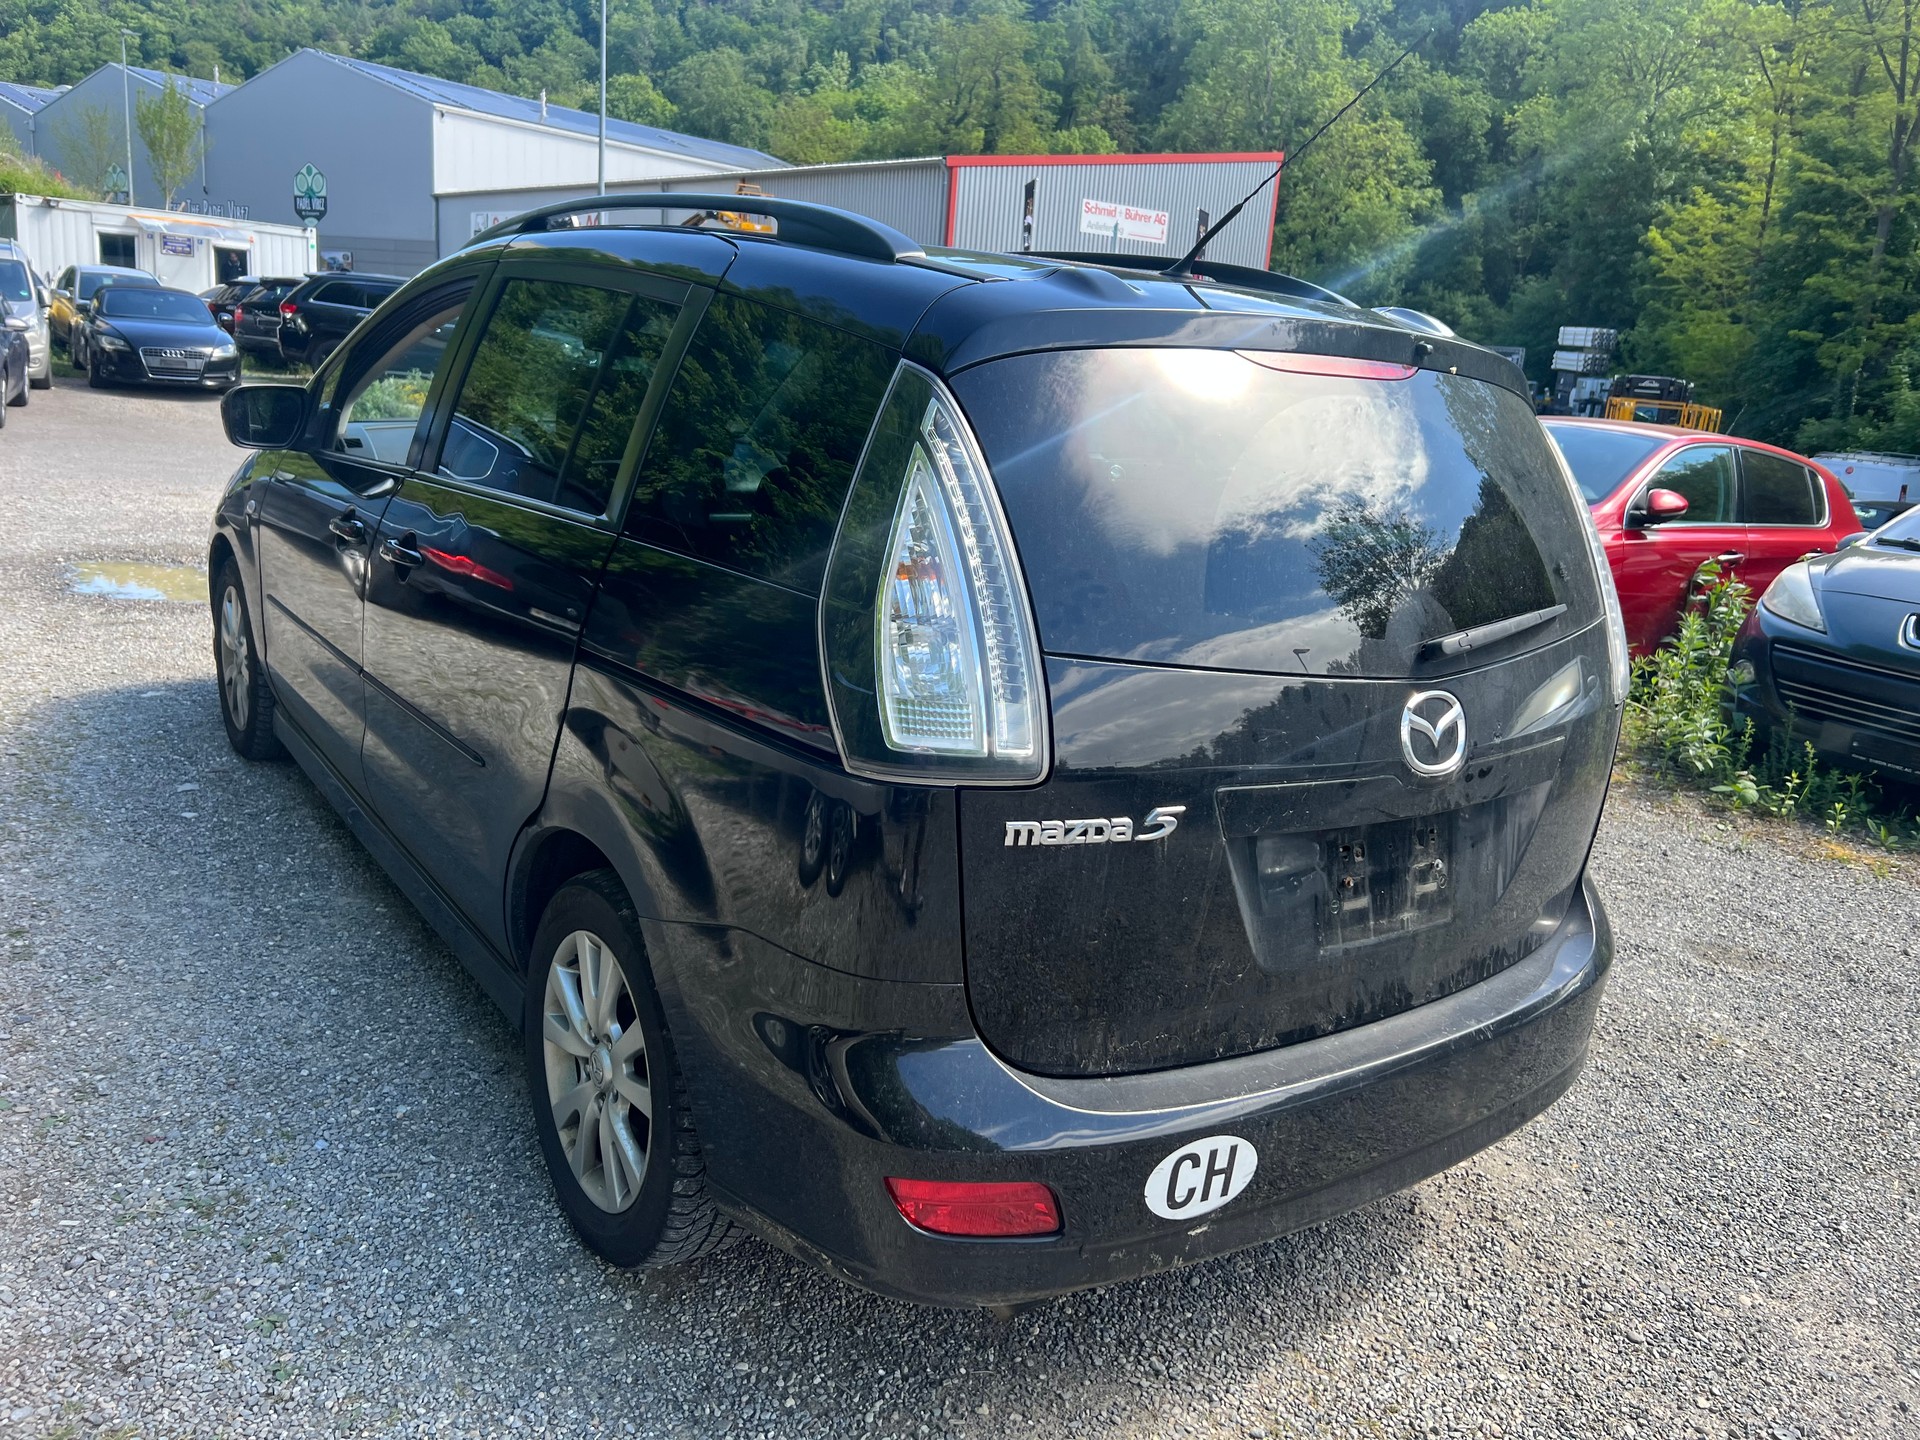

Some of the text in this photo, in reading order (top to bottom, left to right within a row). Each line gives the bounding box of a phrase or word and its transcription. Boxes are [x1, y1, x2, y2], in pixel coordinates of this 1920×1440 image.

[1084, 201, 1117, 218] Schmid
[1125, 208, 1151, 223] Bührer
[1154, 213, 1166, 226] AG
[1004, 805, 1187, 846] mazda 5
[1166, 1143, 1239, 1210] CH
